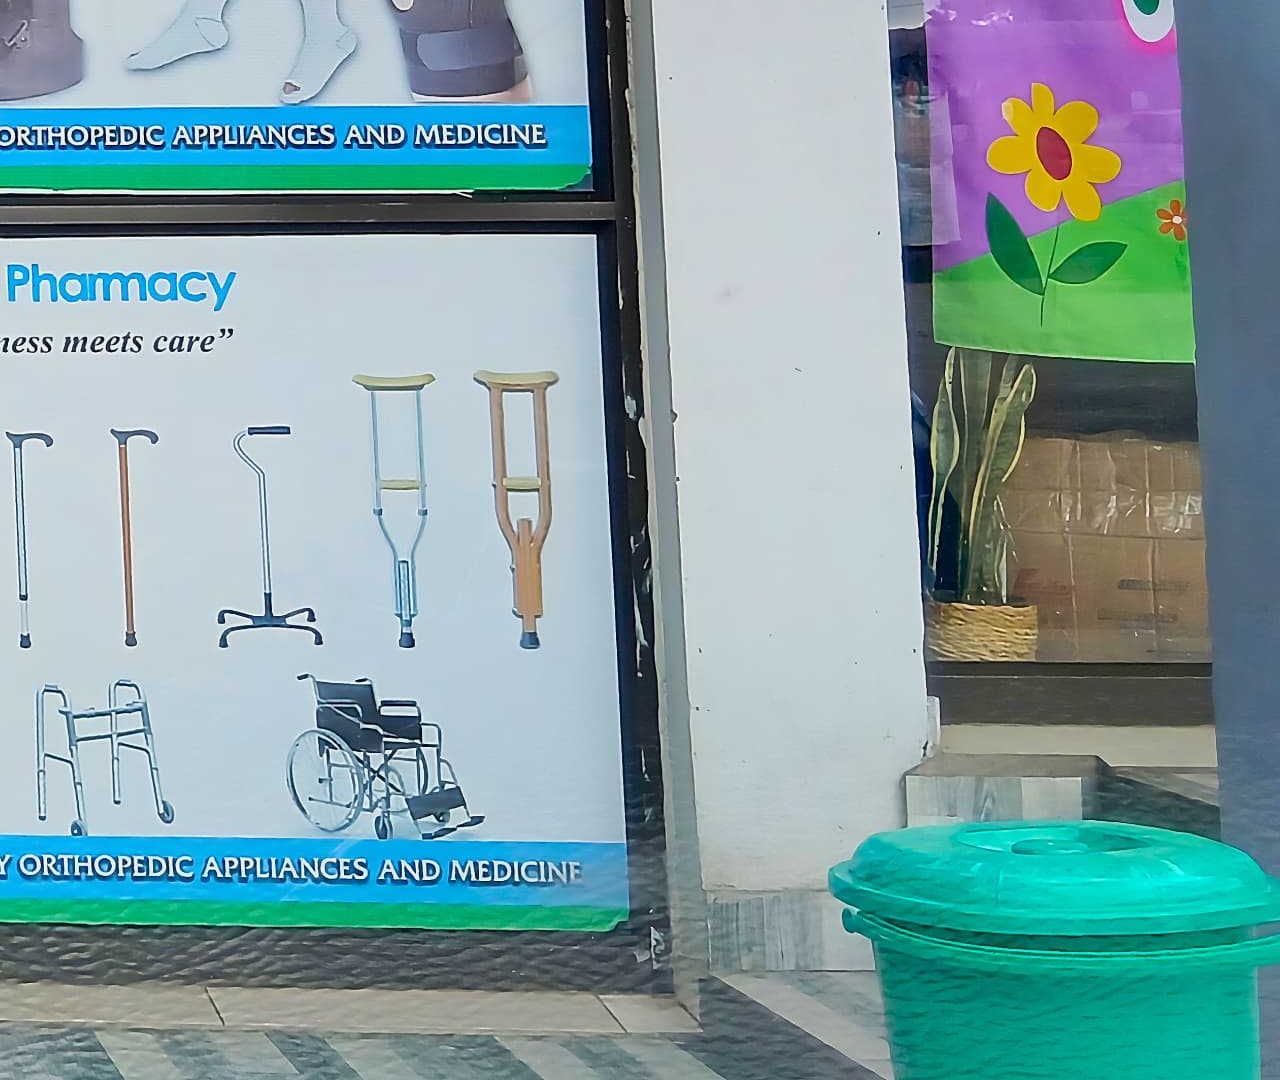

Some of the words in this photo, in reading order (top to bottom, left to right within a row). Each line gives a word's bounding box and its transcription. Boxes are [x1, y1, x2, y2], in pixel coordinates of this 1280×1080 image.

[171, 123, 336, 148] APPLIANCES
[344, 123, 407, 148] AND
[413, 122, 548, 148] MEDICINE
[7, 263, 237, 312] Pharmacy
[62, 331, 142, 354] meets
[18, 853, 195, 879] ORTHOPEDIC
[201, 855, 369, 881] APPLIANCES
[377, 856, 442, 883] AND
[450, 858, 582, 884] MEDICINE
